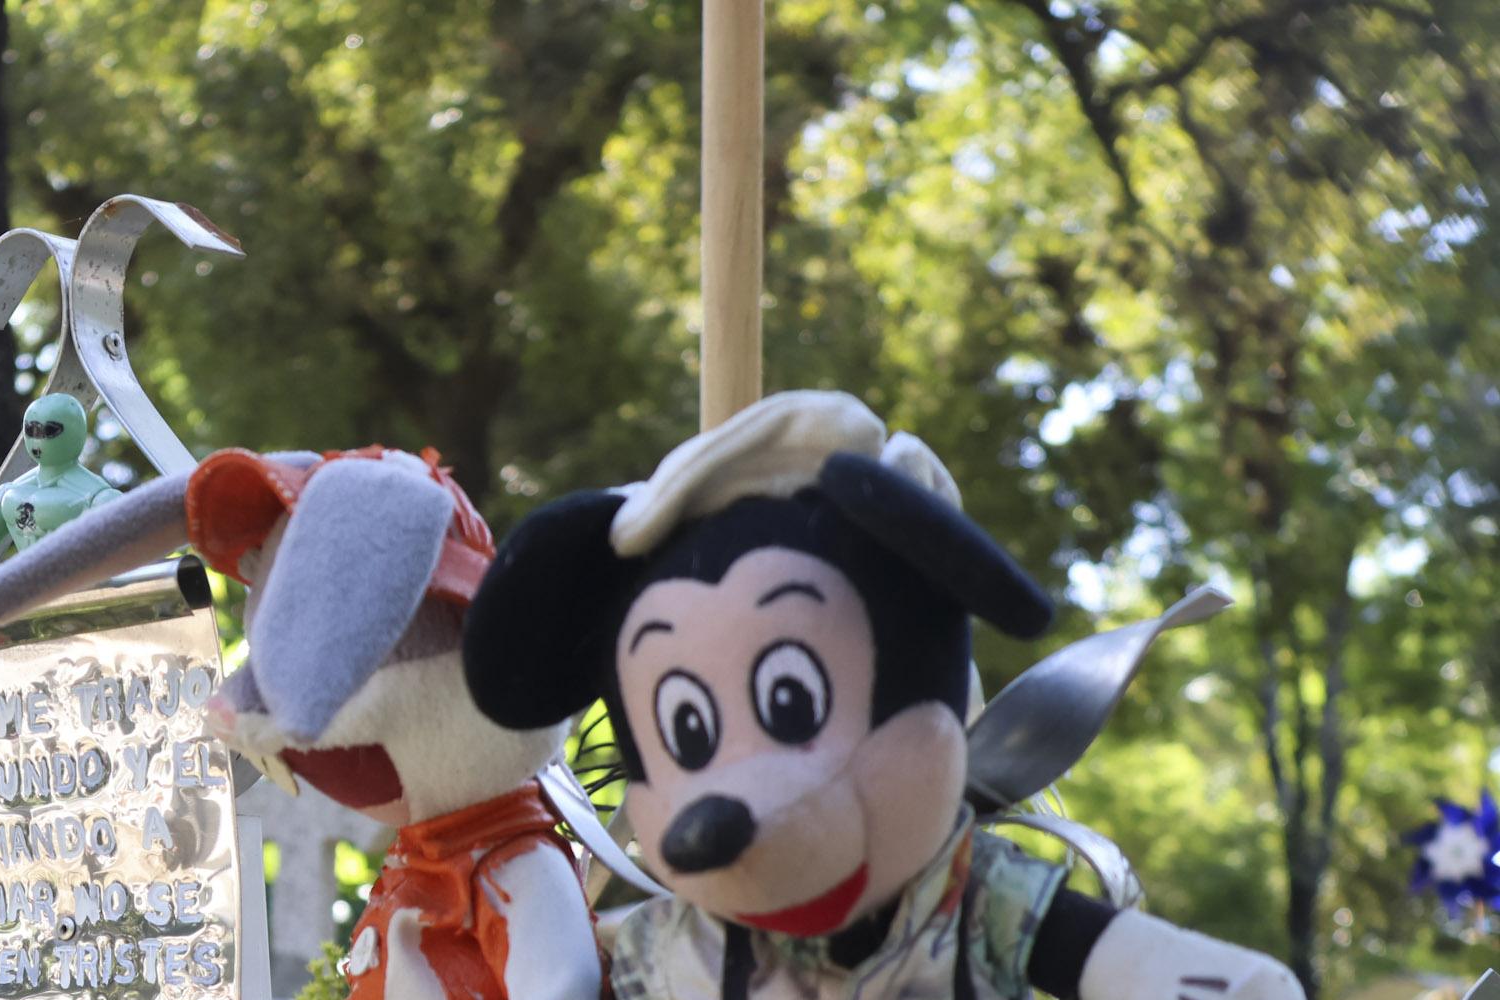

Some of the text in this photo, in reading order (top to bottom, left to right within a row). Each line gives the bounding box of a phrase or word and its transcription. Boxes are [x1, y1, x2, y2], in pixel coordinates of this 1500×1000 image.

[74, 667, 212, 729] TRAJO
[125, 744, 149, 791] Y
[172, 742, 226, 788] EL
[143, 806, 173, 851] A
[72, 881, 127, 926] NO
[145, 880, 203, 926] SE
[55, 937, 222, 989] TRISTES
